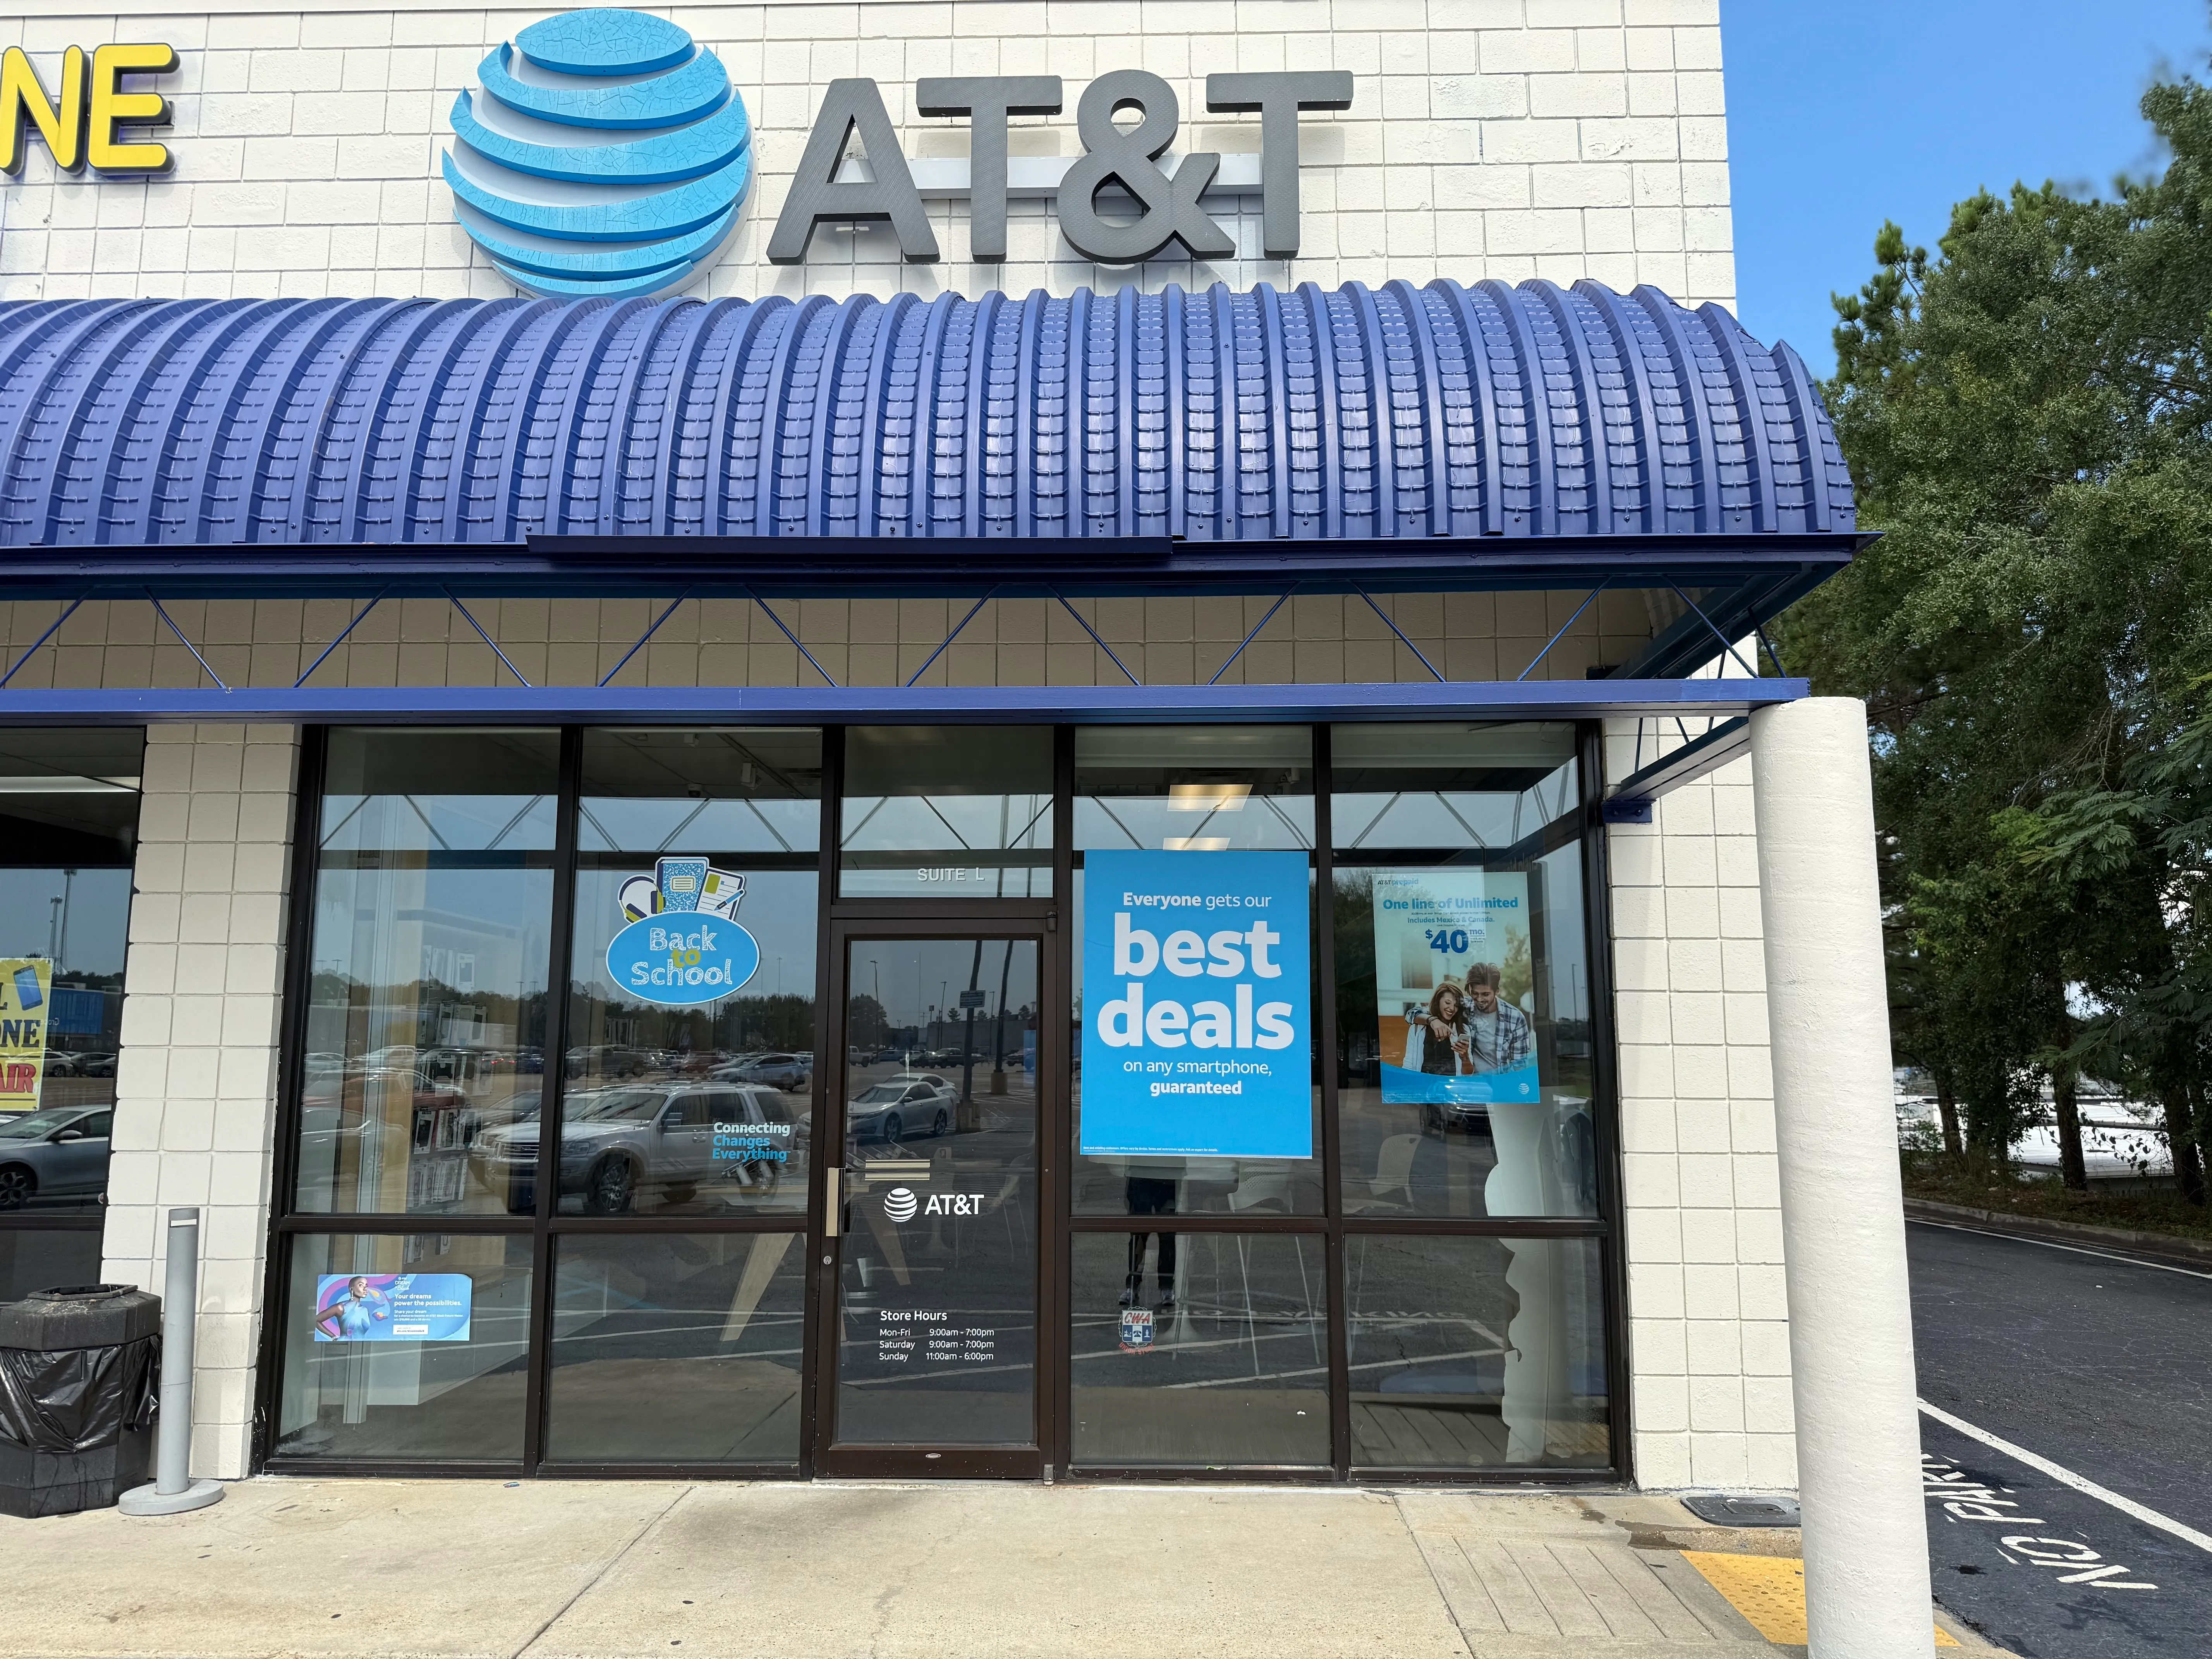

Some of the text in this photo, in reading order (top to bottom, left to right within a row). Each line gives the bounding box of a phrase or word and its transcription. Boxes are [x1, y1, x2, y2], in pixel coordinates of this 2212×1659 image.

[0, 43, 180, 176] NE
[767, 70, 1353, 265] AT&T
[917, 867, 984, 881] SUITE L
[1123, 892, 1271, 910] Everyone gets our
[1383, 897, 1518, 909] One line of Unlimited
[649, 925, 717, 950] Back
[1114, 912, 1282, 978] best
[1425, 929, 1468, 953] $40
[671, 948, 701, 968] to
[631, 959, 733, 986] School
[1097, 982, 1295, 1050] deals
[0, 1019, 41, 1047] NE
[1123, 1060, 1272, 1077] on any smartphone,
[1150, 1081, 1242, 1097] guaranteed
[714, 1122, 790, 1137] Connecting
[713, 1134, 770, 1149] Changes
[925, 1194, 984, 1215] AT&T
[880, 1310, 947, 1321] Store Hours
[1124, 1312, 1151, 1324] CWA
[965, 1329, 994, 1338] 7:00pm
[879, 1340, 915, 1350] Saturday
[965, 1340, 994, 1350] 7:00pm
[1119, 1342, 1136, 1355] UNION
[879, 1352, 908, 1362] Sunday
[964, 1353, 994, 1362] 6:00pm
[2001, 1535, 2159, 1589] NO
